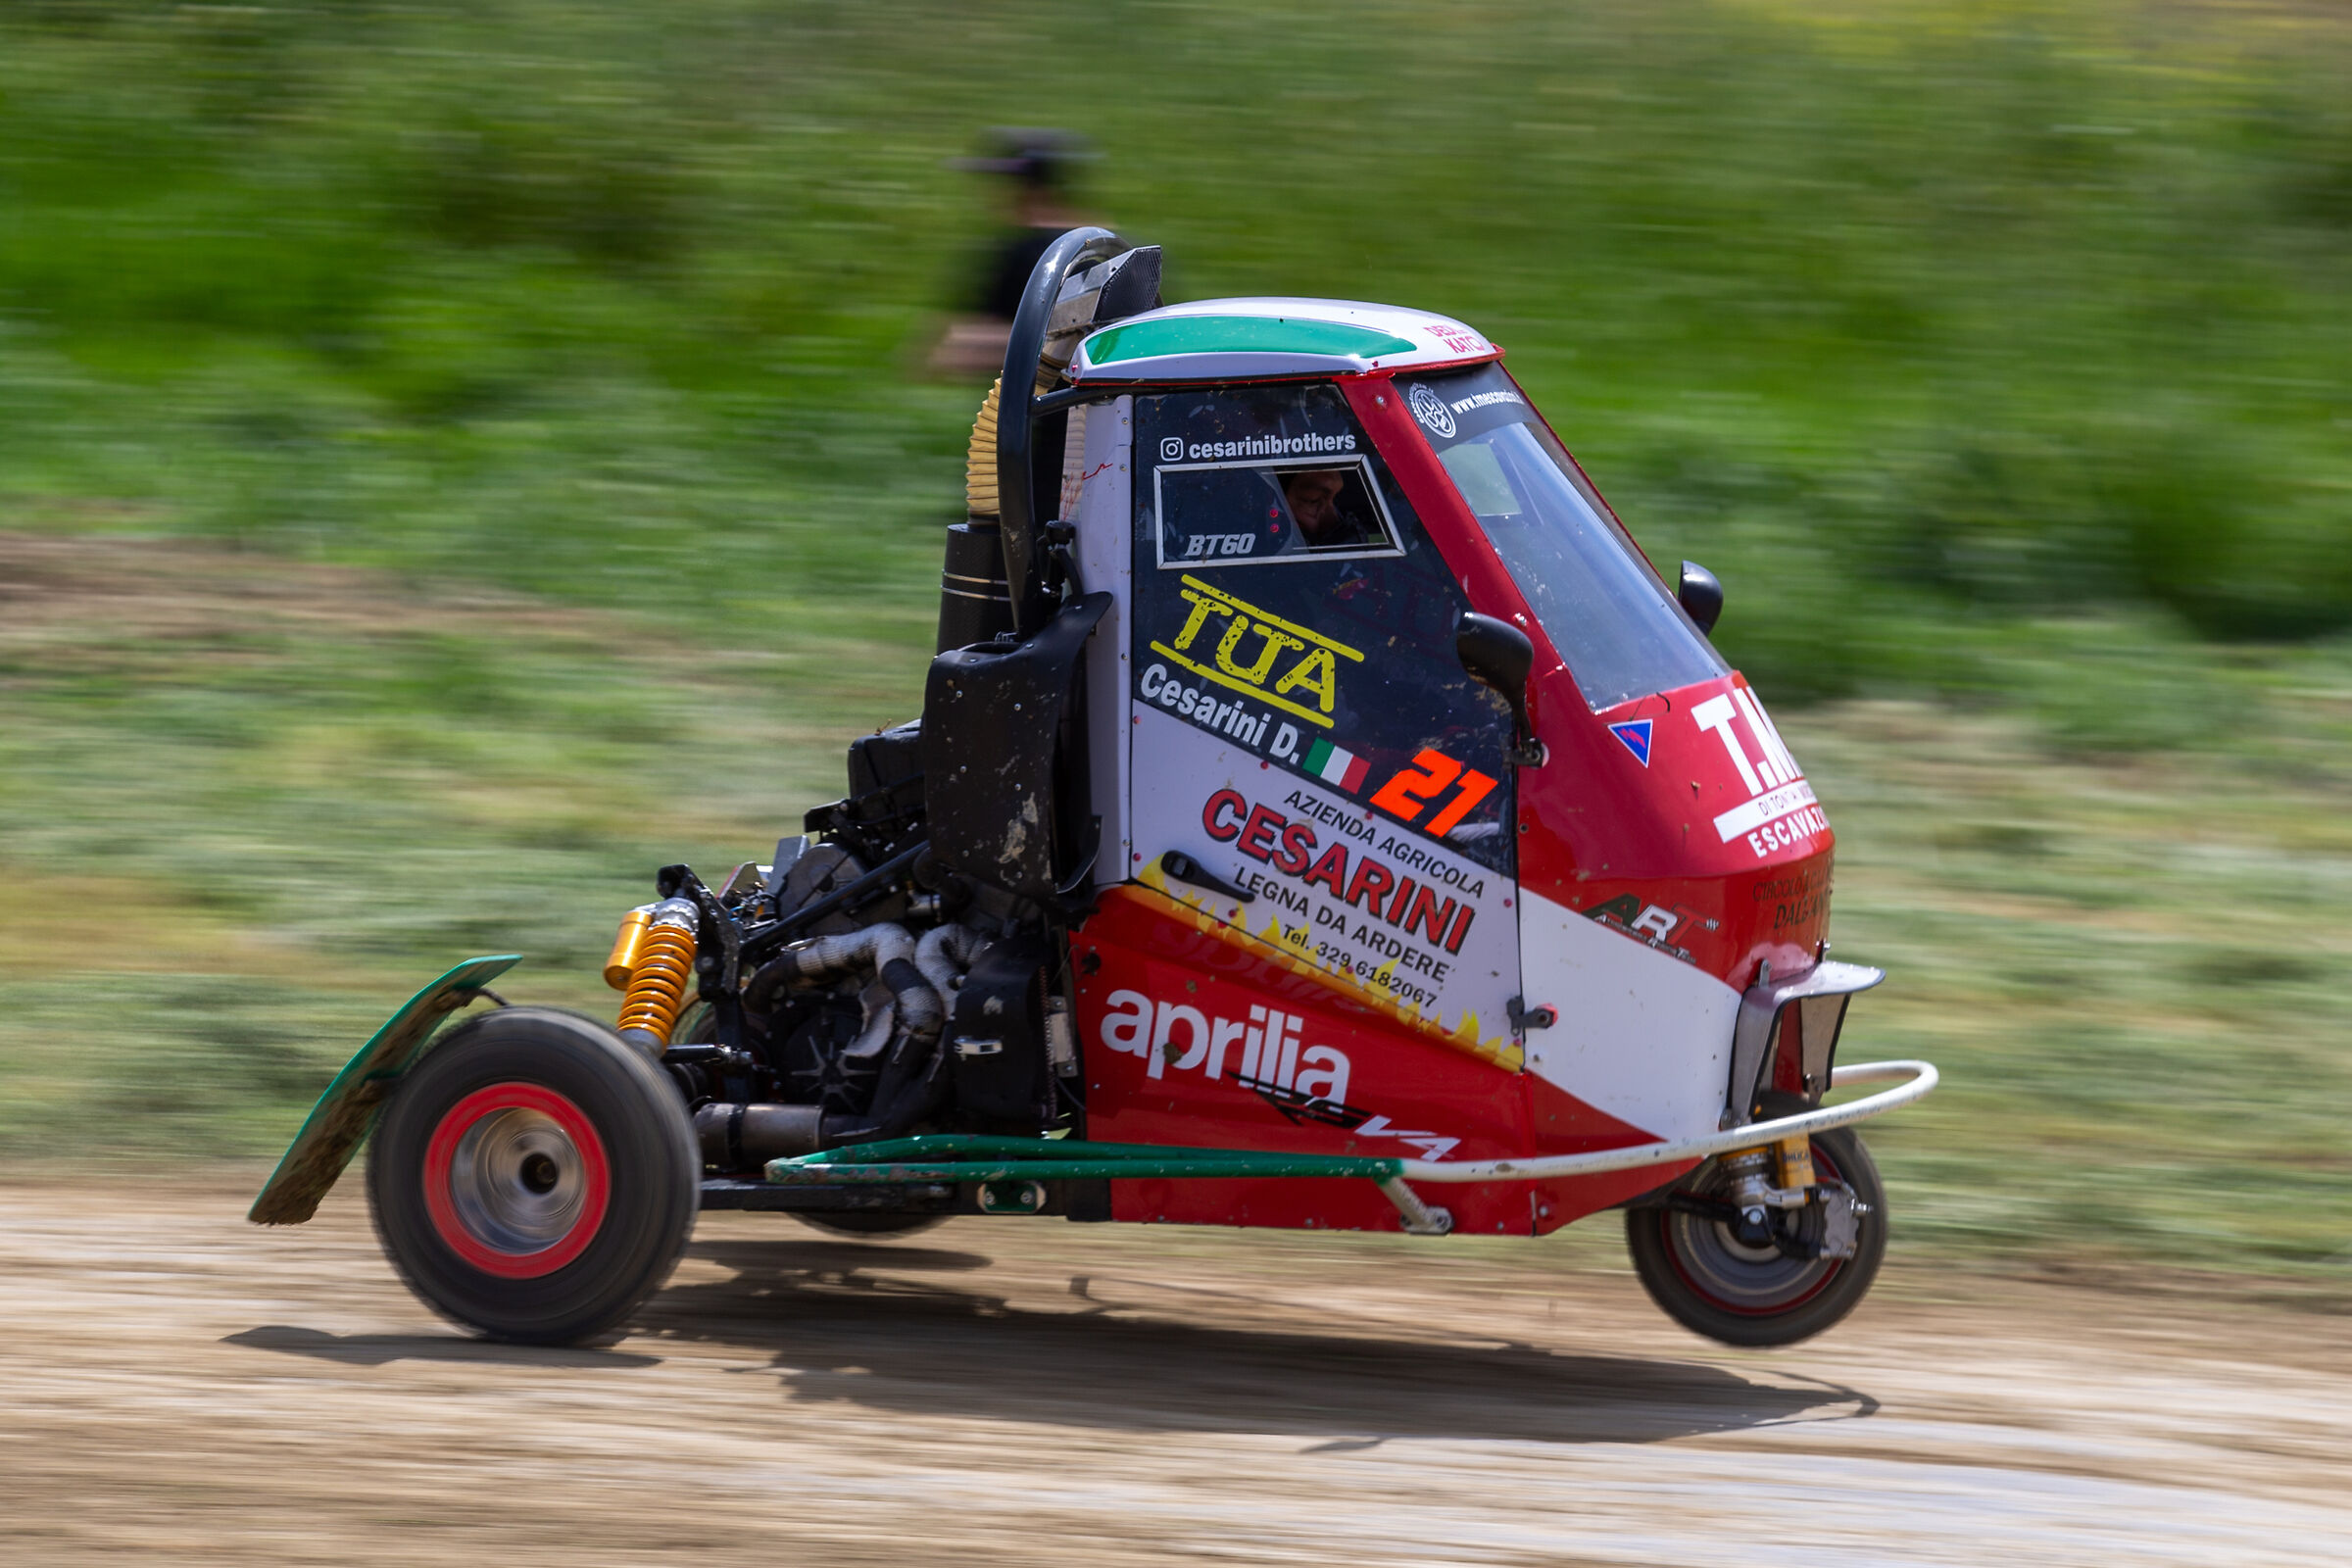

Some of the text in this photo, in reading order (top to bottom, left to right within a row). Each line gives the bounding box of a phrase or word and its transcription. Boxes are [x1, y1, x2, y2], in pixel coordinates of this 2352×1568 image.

[1443, 335, 1486, 354] KATO
[1188, 432, 1356, 460] cesarinibrothers
[1184, 532, 1256, 557] BT60
[1141, 663, 1299, 764] Cesarini D.
[1370, 747, 1498, 838] 21
[1201, 787, 1475, 957] CESARINI
[1284, 790, 1485, 899] AZIENDA AGRICOLA
[1235, 866, 1449, 983] LEGNA DA ARDERE
[1282, 923, 1438, 1010] Tel. 329 6182067
[1100, 989, 1351, 1113] aprilia
